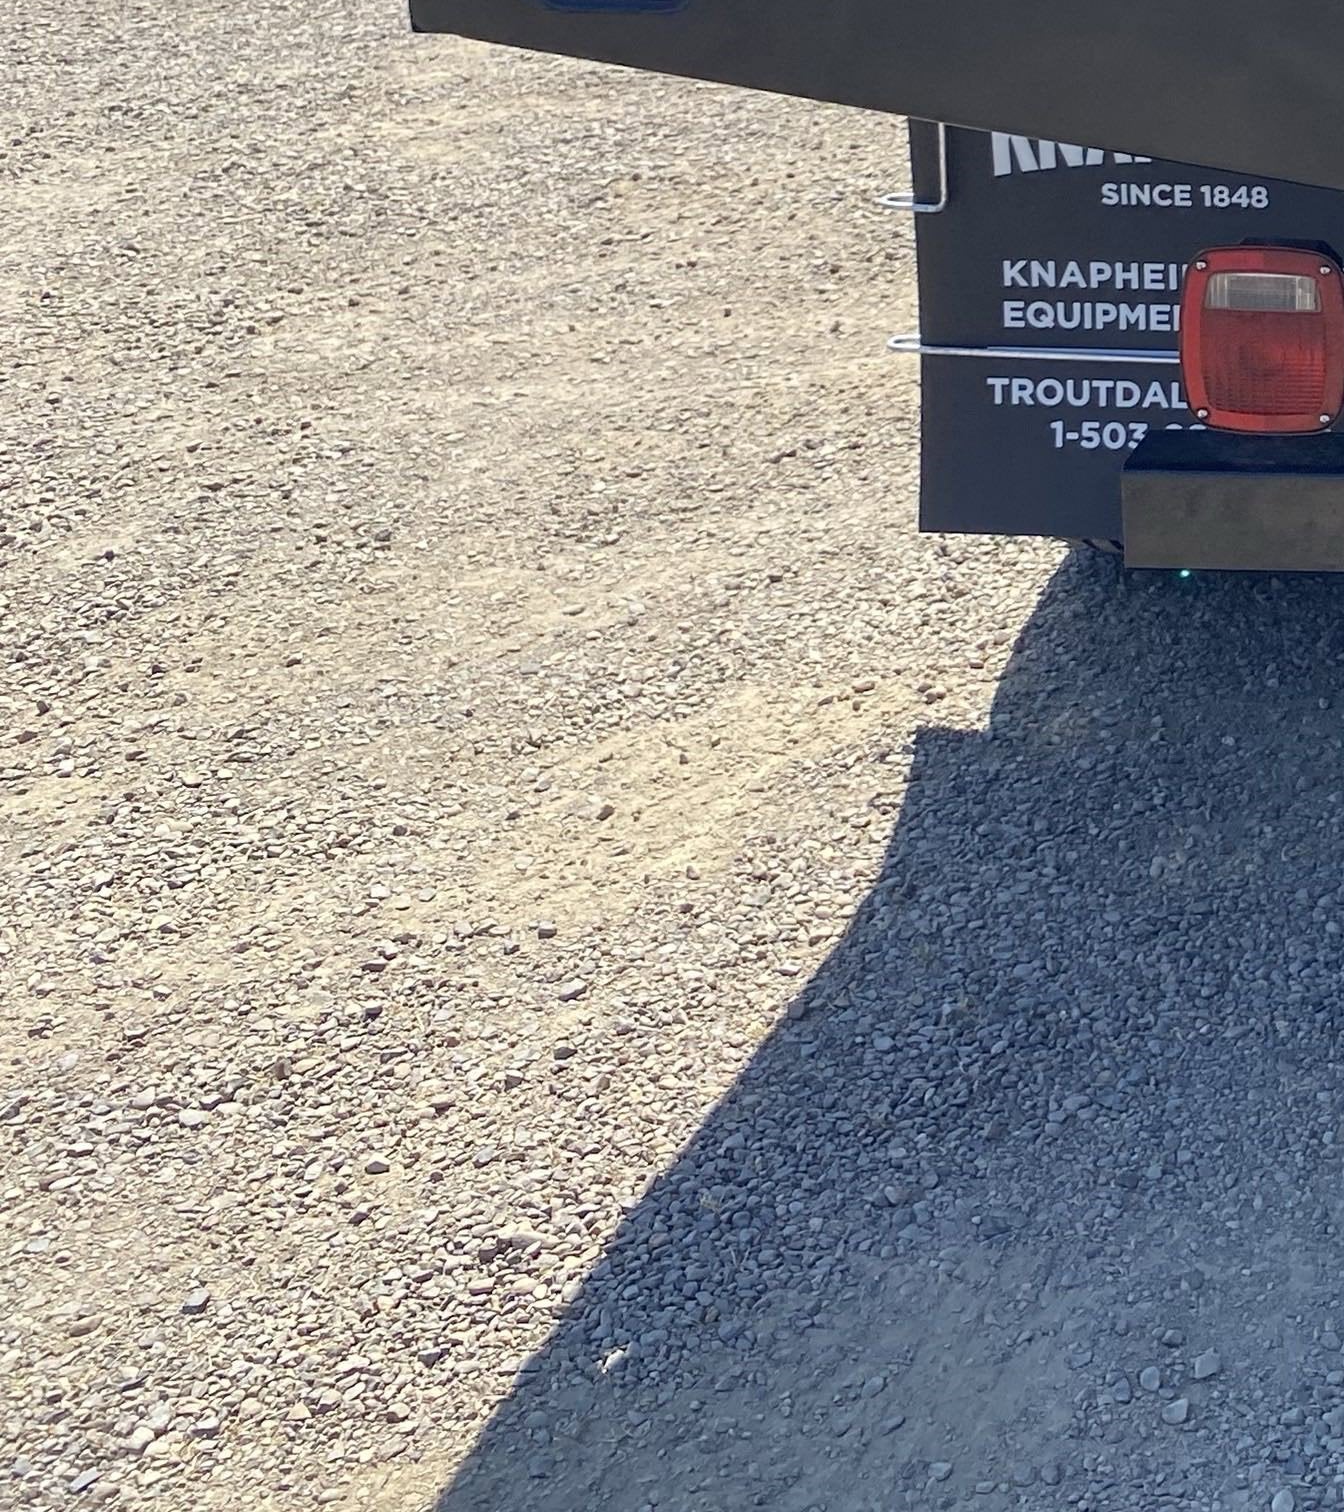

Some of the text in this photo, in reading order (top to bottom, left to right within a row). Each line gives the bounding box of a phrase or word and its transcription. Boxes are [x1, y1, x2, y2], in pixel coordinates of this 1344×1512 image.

[1100, 182, 1269, 209] SINCE 1848
[1002, 259, 1186, 290] KNAPHEI
[1002, 300, 1180, 332] EQUIPME
[987, 376, 1188, 410] TROUTDAL
